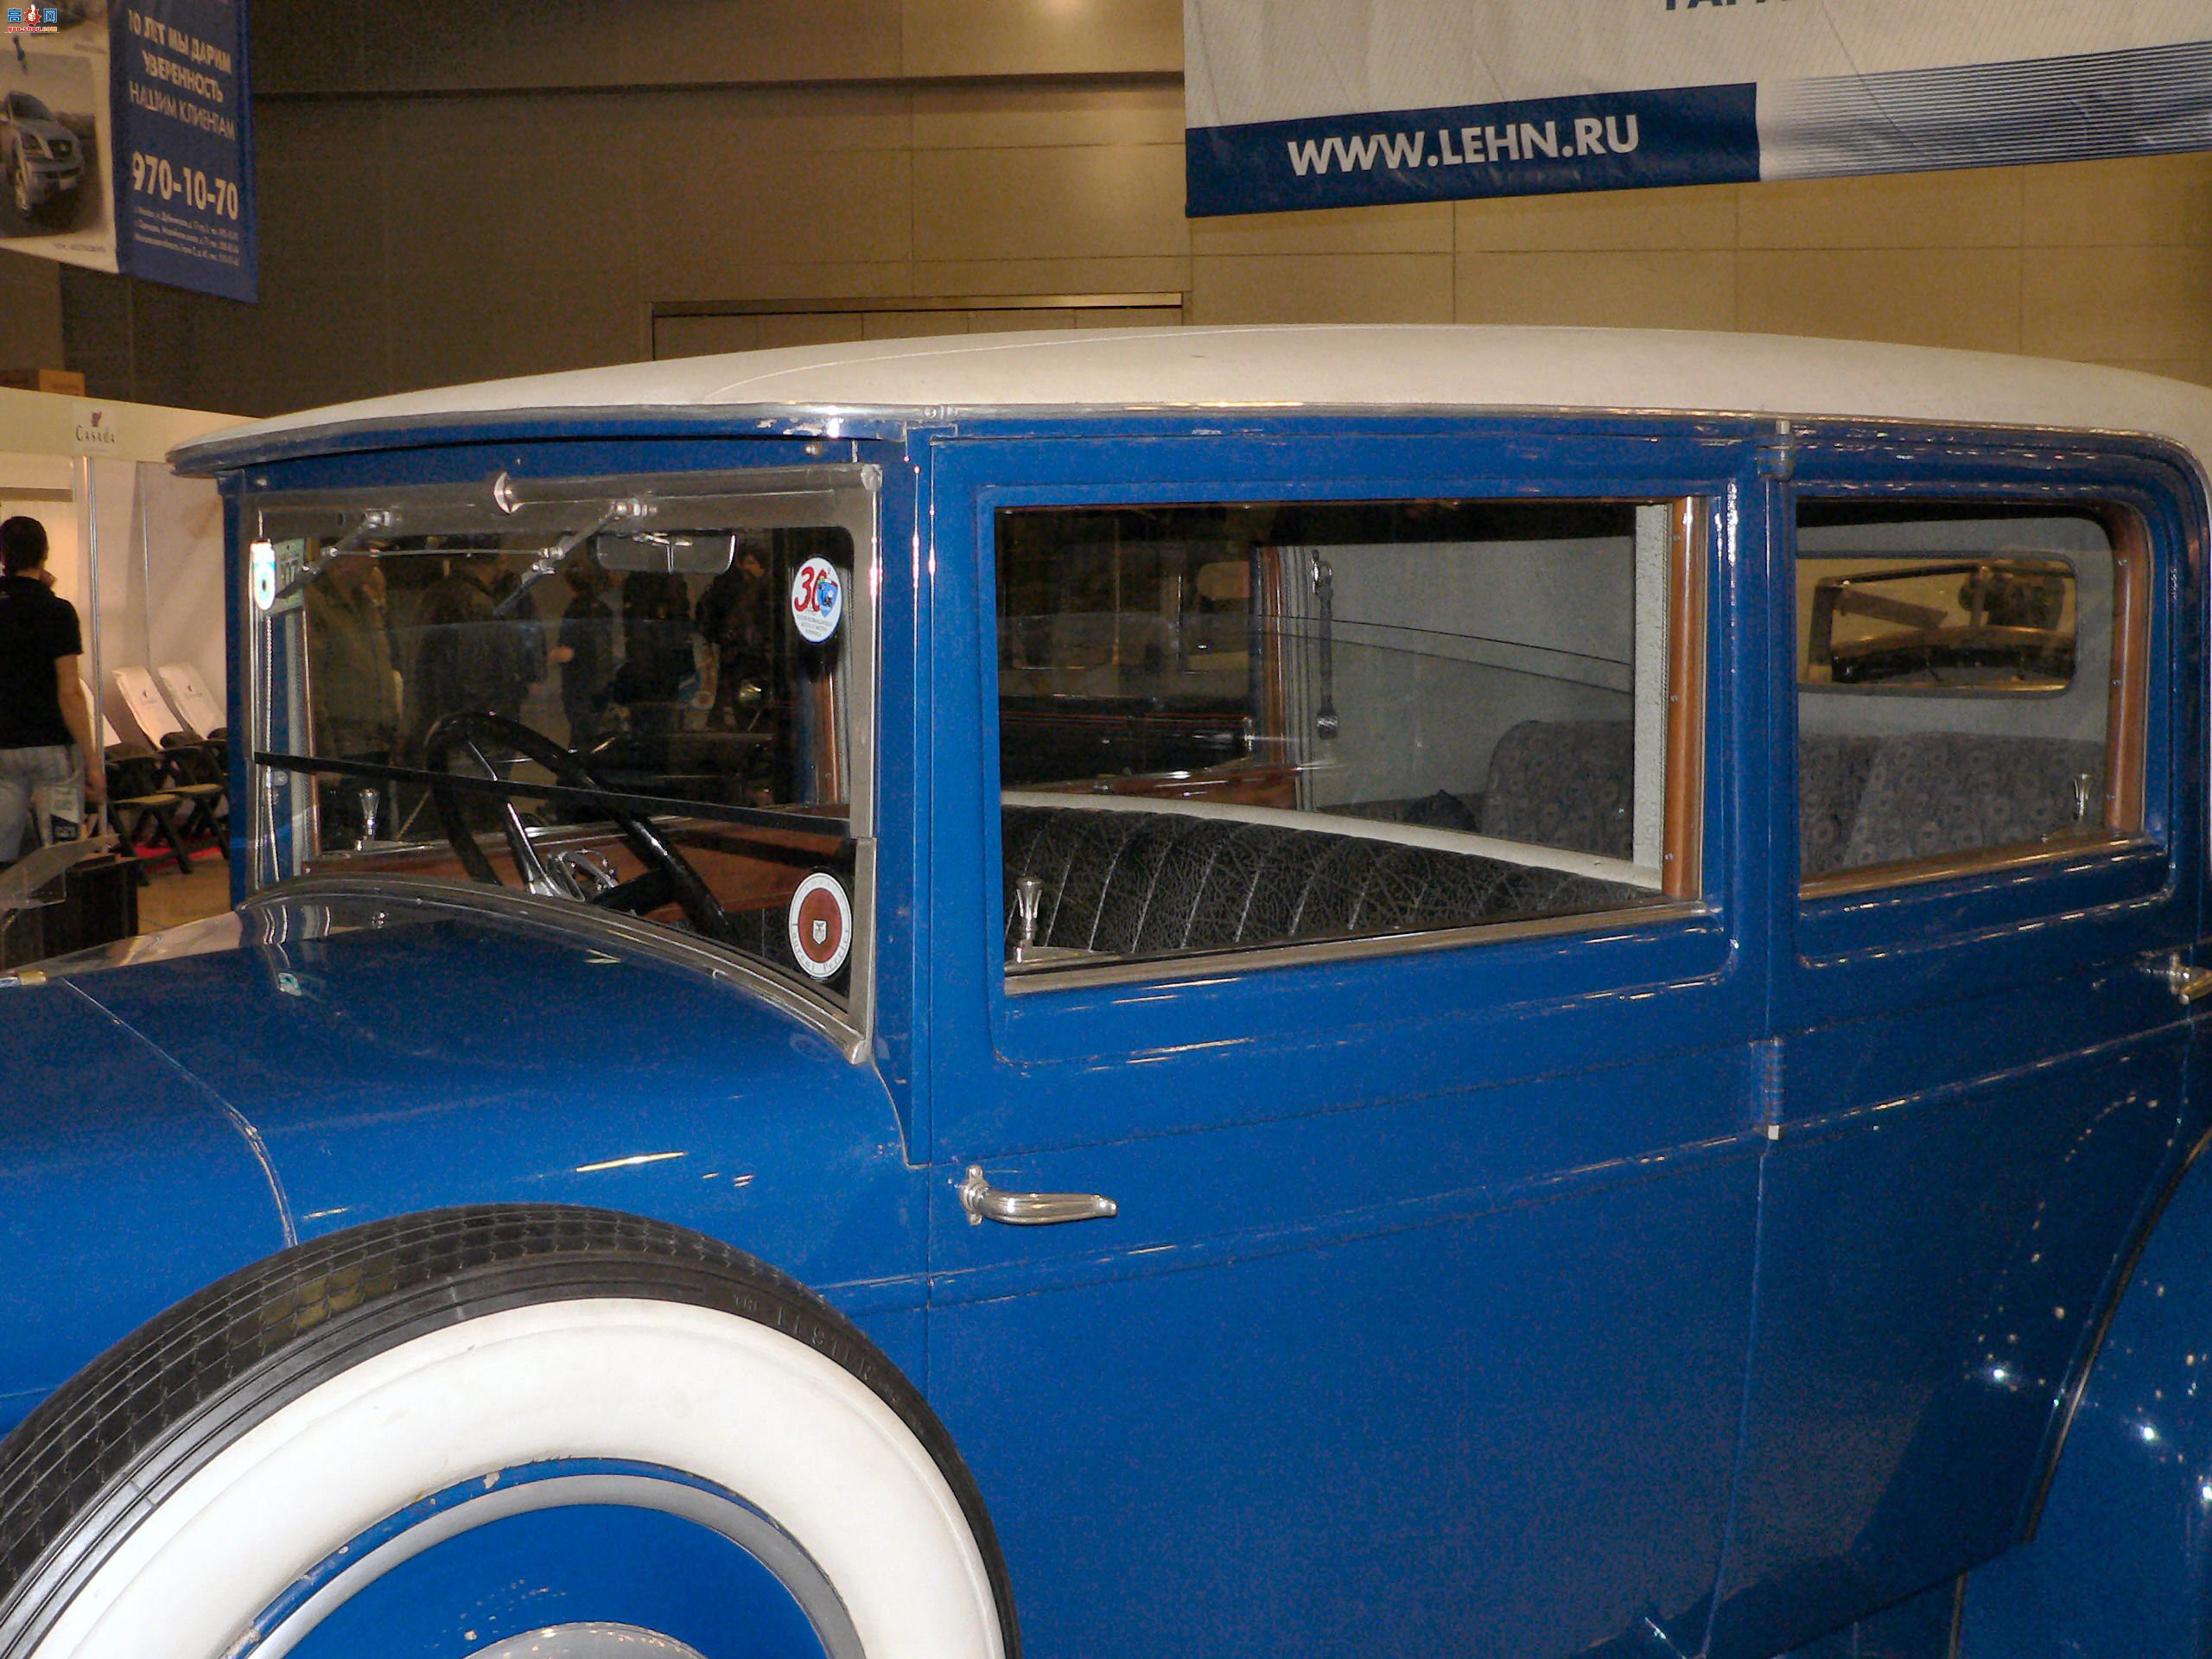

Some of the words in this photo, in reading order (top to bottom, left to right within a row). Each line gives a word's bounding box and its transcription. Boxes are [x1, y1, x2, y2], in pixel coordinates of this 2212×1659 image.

[141, 49, 224, 103] УВЕРЕННОСТЬ
[143, 16, 165, 46] ЛЕТ
[168, 27, 188, 55] МЫ
[191, 37, 232, 74] ДАРИМ
[130, 80, 178, 119] НАШИМ
[179, 99, 236, 142] КЛИЕНТАМ
[1287, 114, 1640, 176] WWW.LEHN.RU
[131, 150, 239, 220] 970-10-70
